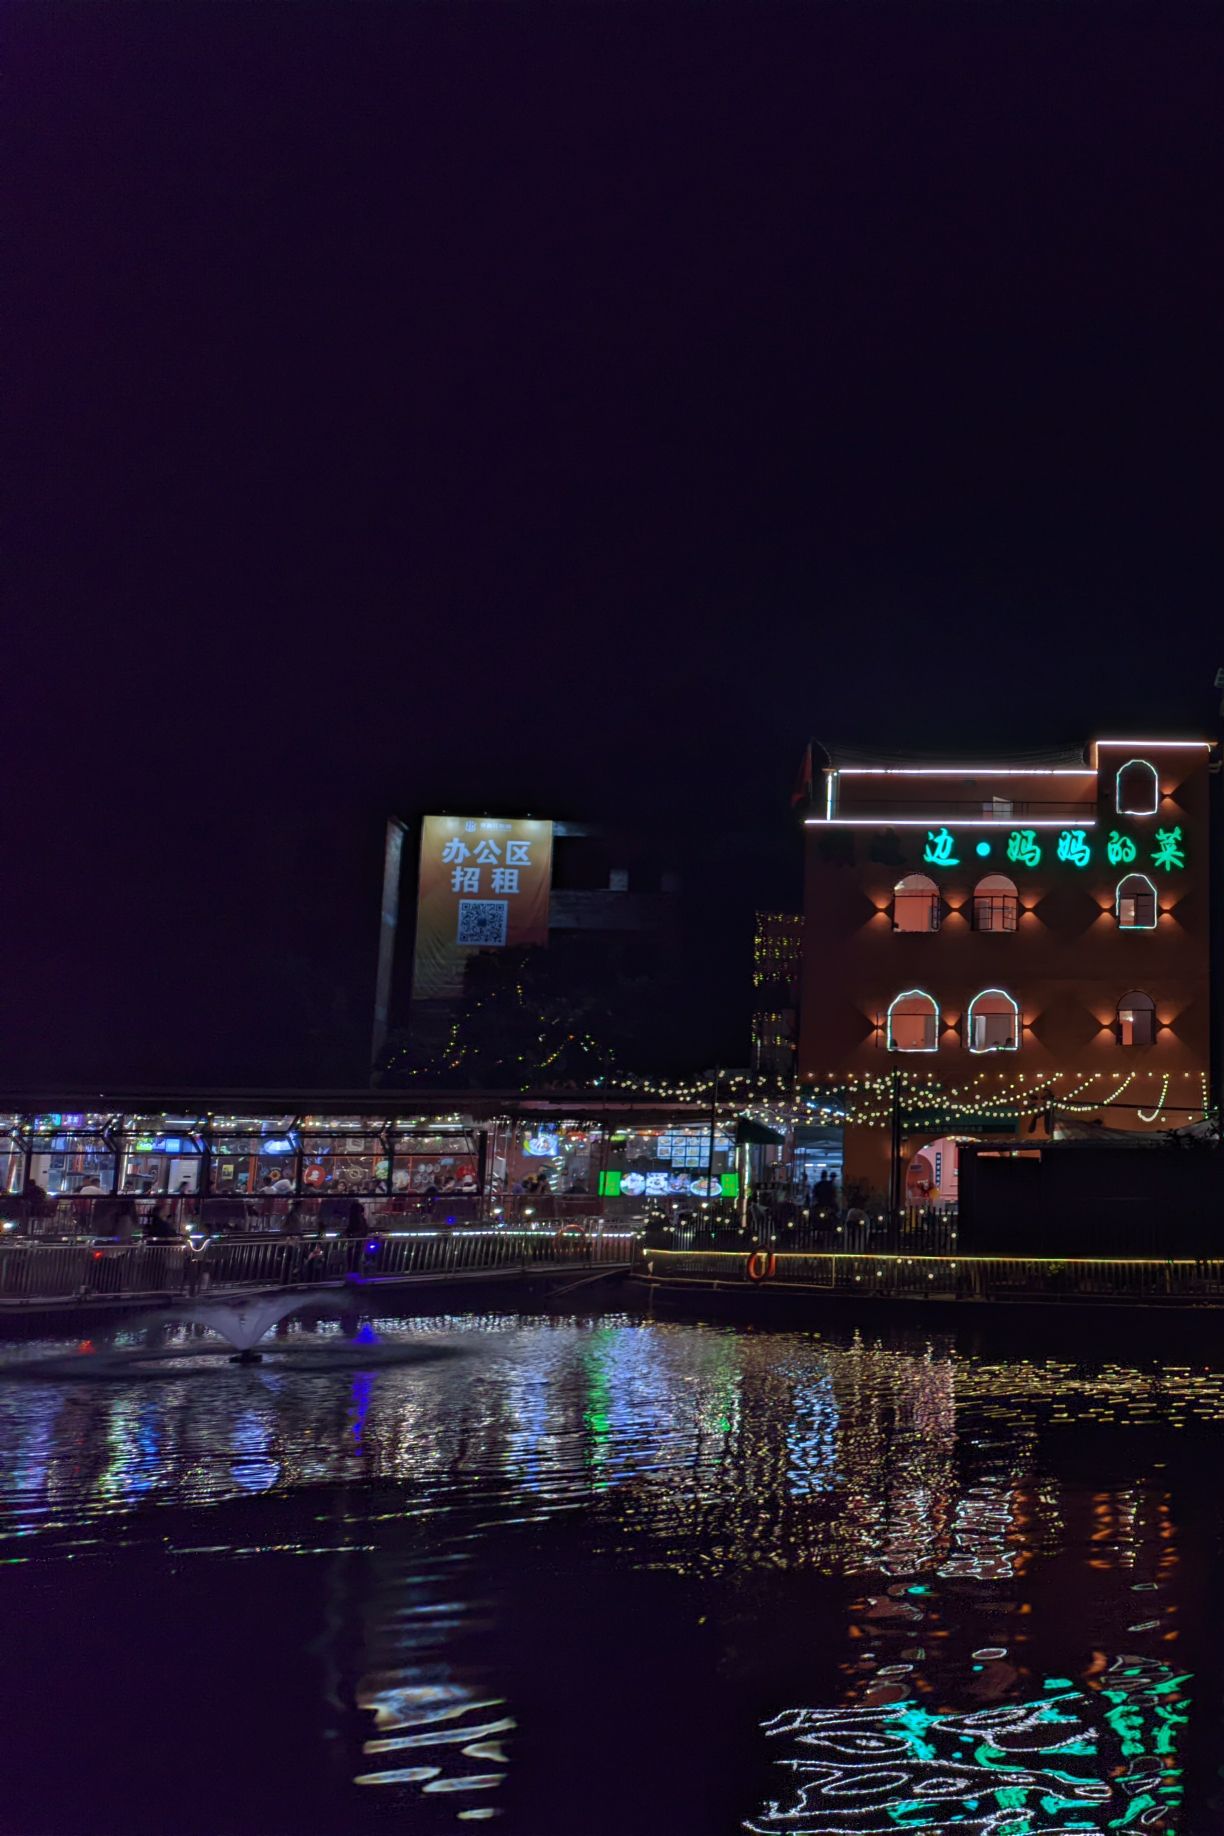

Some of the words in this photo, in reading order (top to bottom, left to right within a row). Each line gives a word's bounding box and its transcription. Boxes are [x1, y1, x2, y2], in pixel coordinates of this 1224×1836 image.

[442, 837, 532, 866] 办公区
[451, 866, 520, 894] 招租
